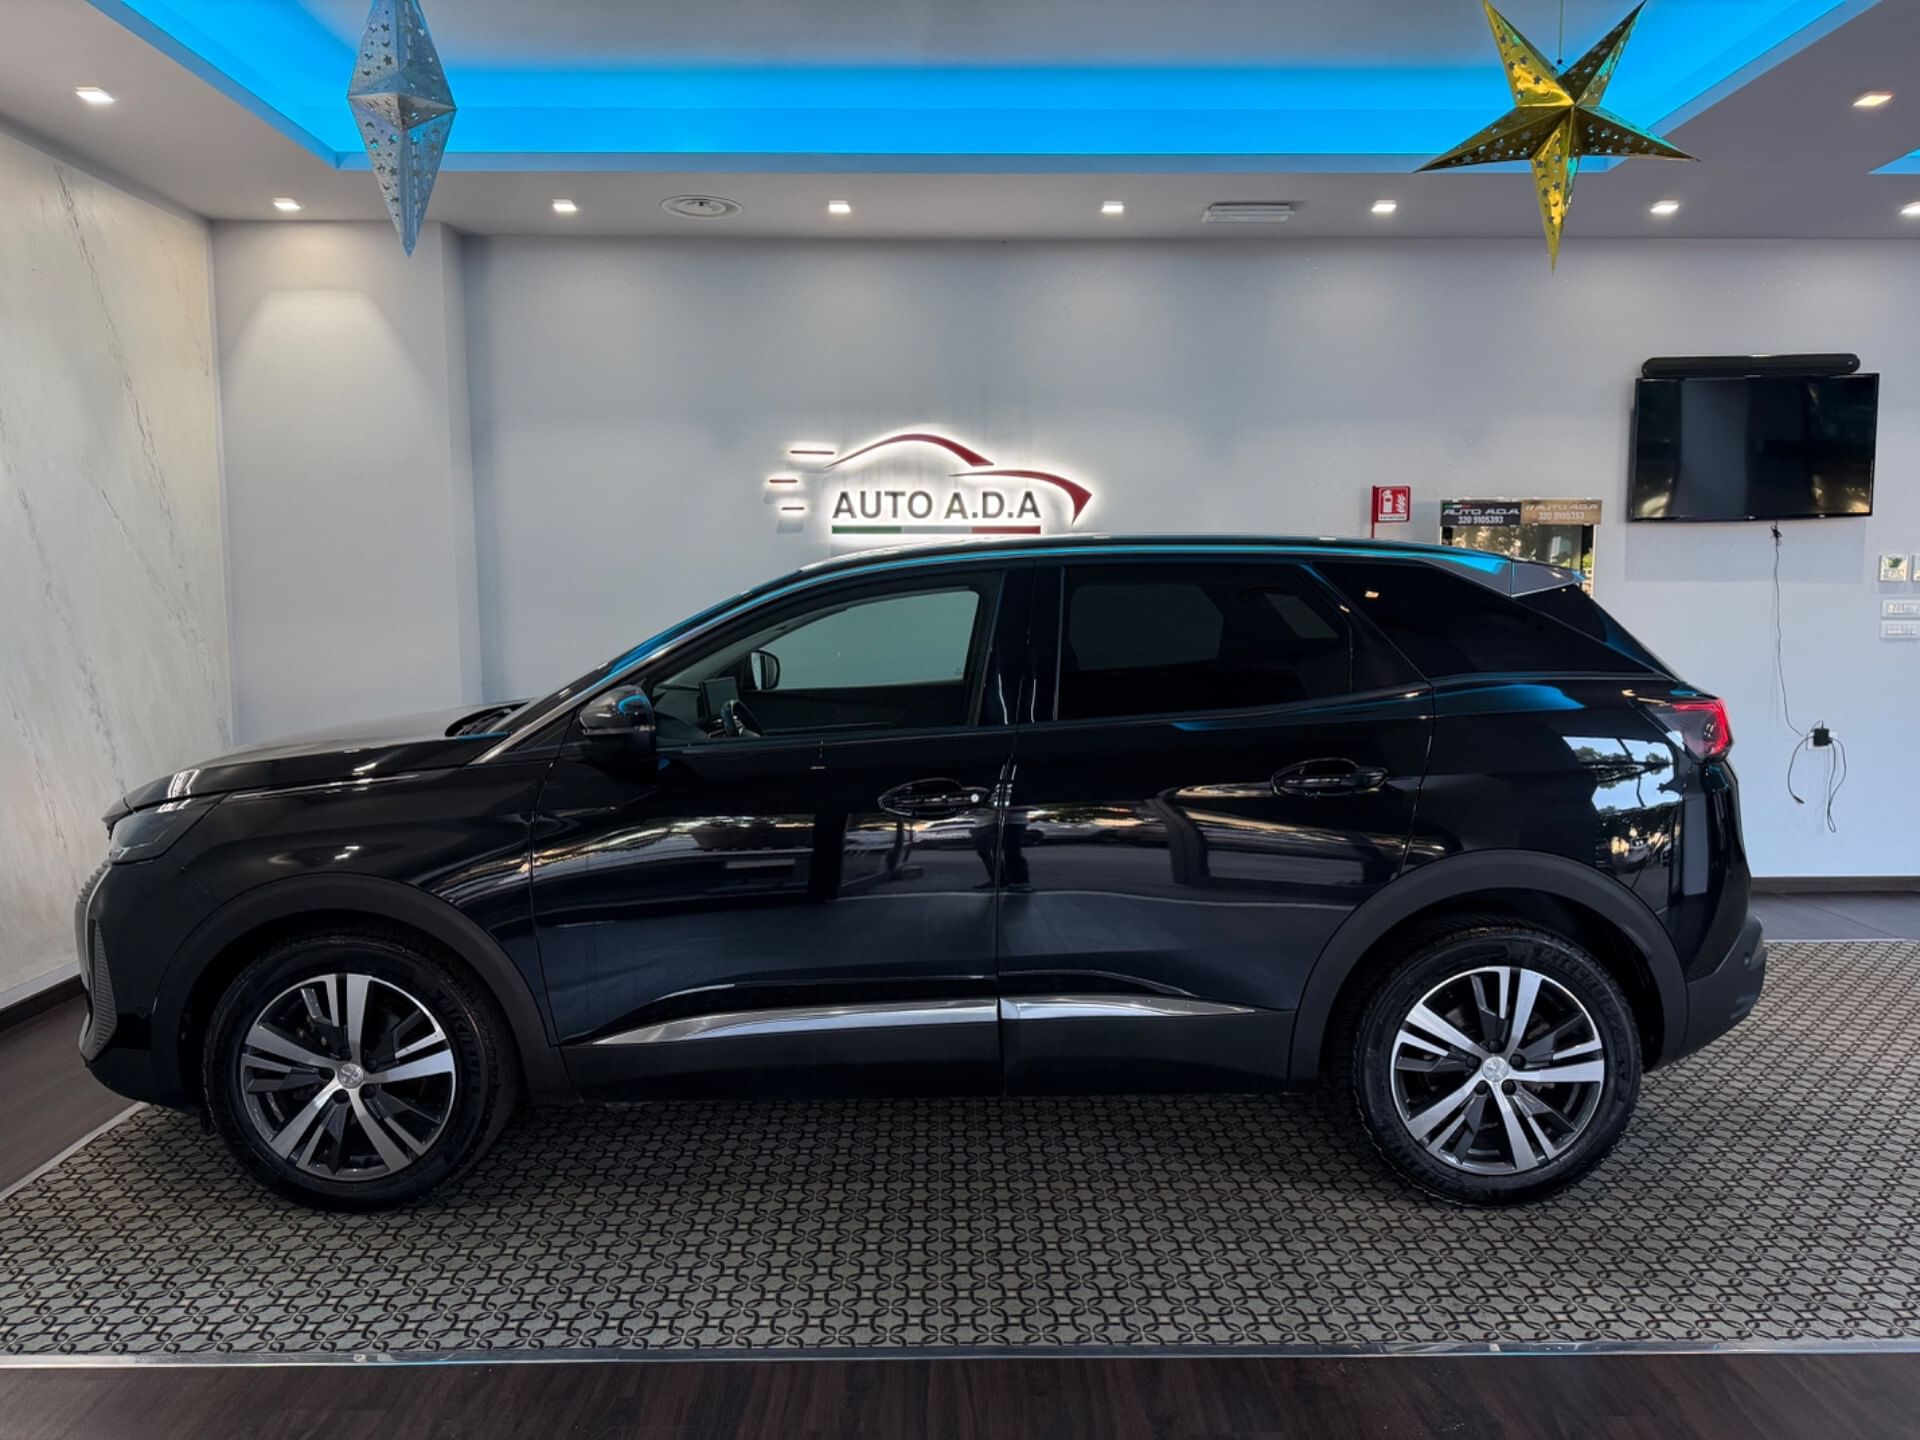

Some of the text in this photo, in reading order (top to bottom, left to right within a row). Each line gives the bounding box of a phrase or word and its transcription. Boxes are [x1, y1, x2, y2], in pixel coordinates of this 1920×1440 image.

[832, 490, 1041, 519] AUTO A.D.A
[1535, 503, 1567, 511] AUTO
[1458, 515, 1472, 524] 320
